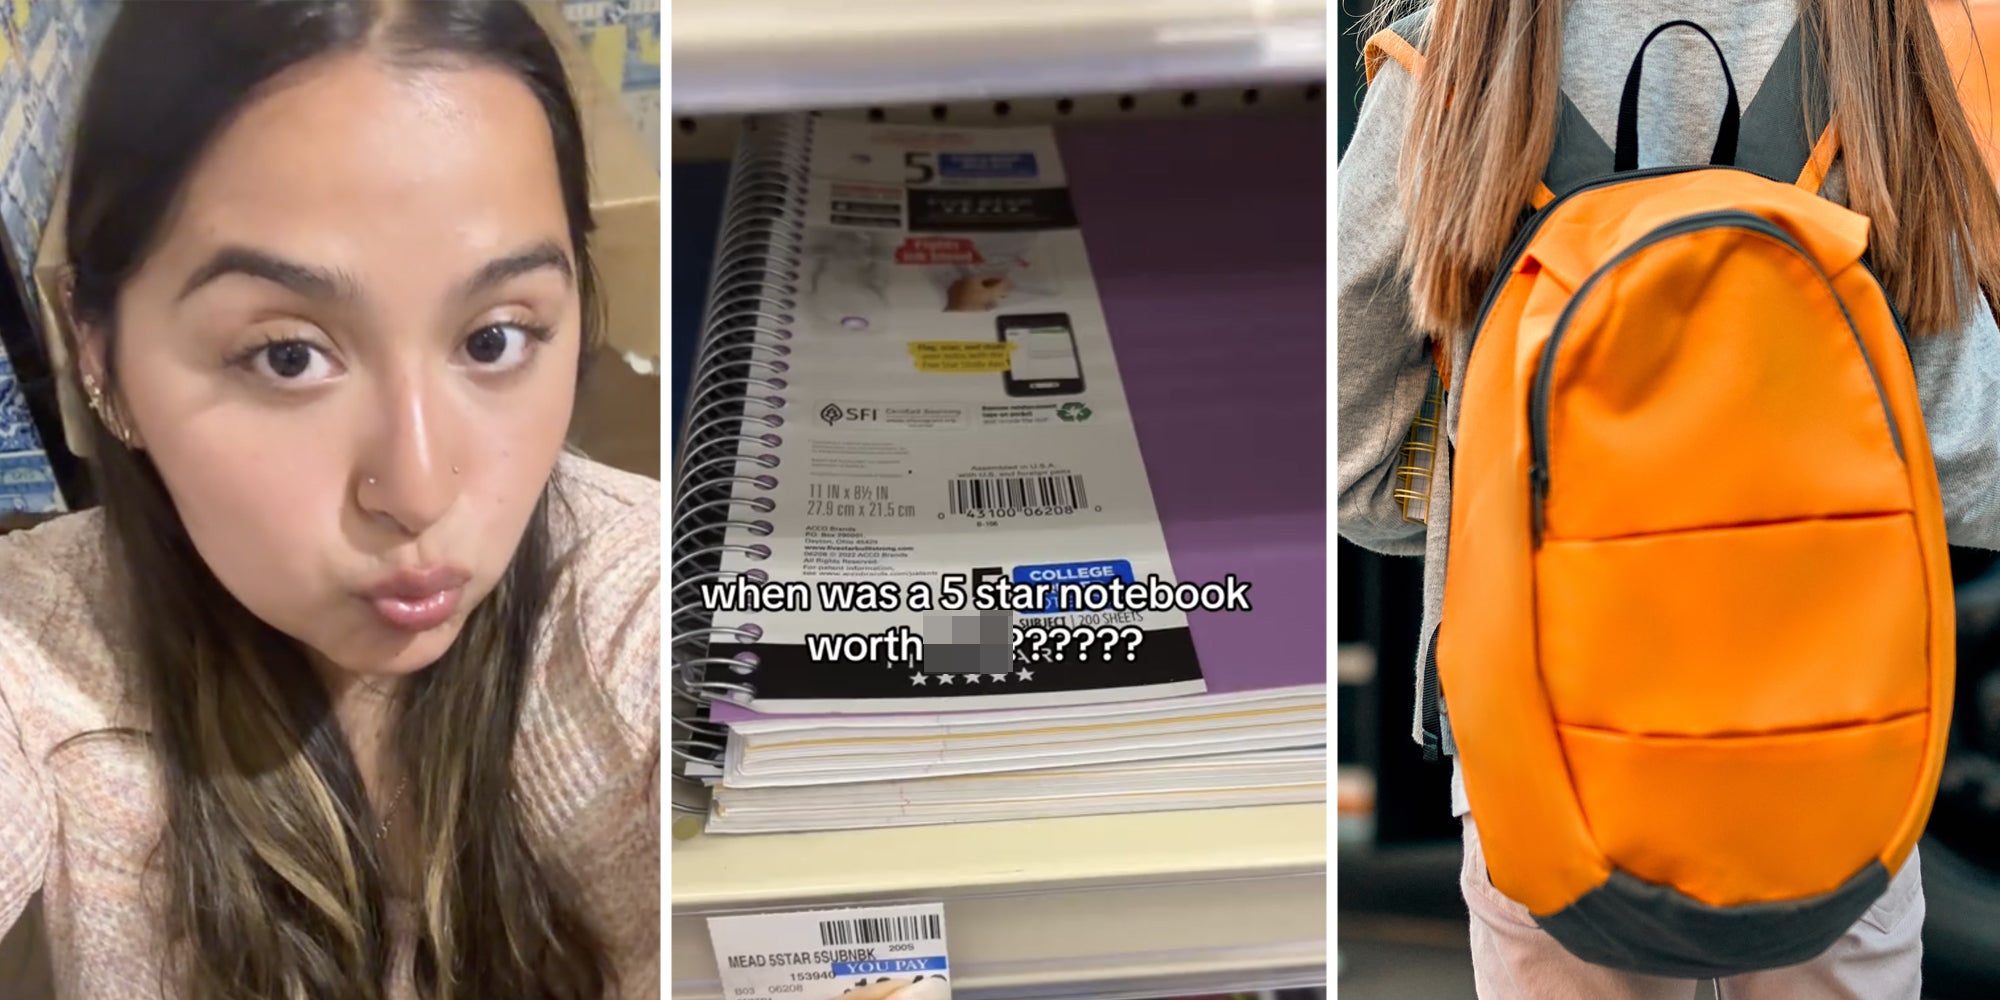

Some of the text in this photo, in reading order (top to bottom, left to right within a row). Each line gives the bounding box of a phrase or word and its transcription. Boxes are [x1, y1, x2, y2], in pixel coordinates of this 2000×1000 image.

[904, 152, 934, 184] 5
[846, 408, 877, 421] SFI
[810, 484, 822, 498] 11
[827, 484, 840, 499] IN
[844, 488, 850, 499] x
[876, 486, 889, 500] IN
[807, 500, 916, 517] 27.9 cm x 21.5 cm
[966, 507, 1016, 518] 43100
[1024, 505, 1074, 517] 06208
[1029, 566, 1115, 581] COLLEGE
[1019, 611, 1144, 630] SUBJECT 200 SHEETS
[728, 948, 876, 968] MEAD 5STAR 5SUBNBK
[846, 959, 929, 973] YOU PAY
[790, 970, 836, 981] 153940
[768, 984, 803, 994] 06208
